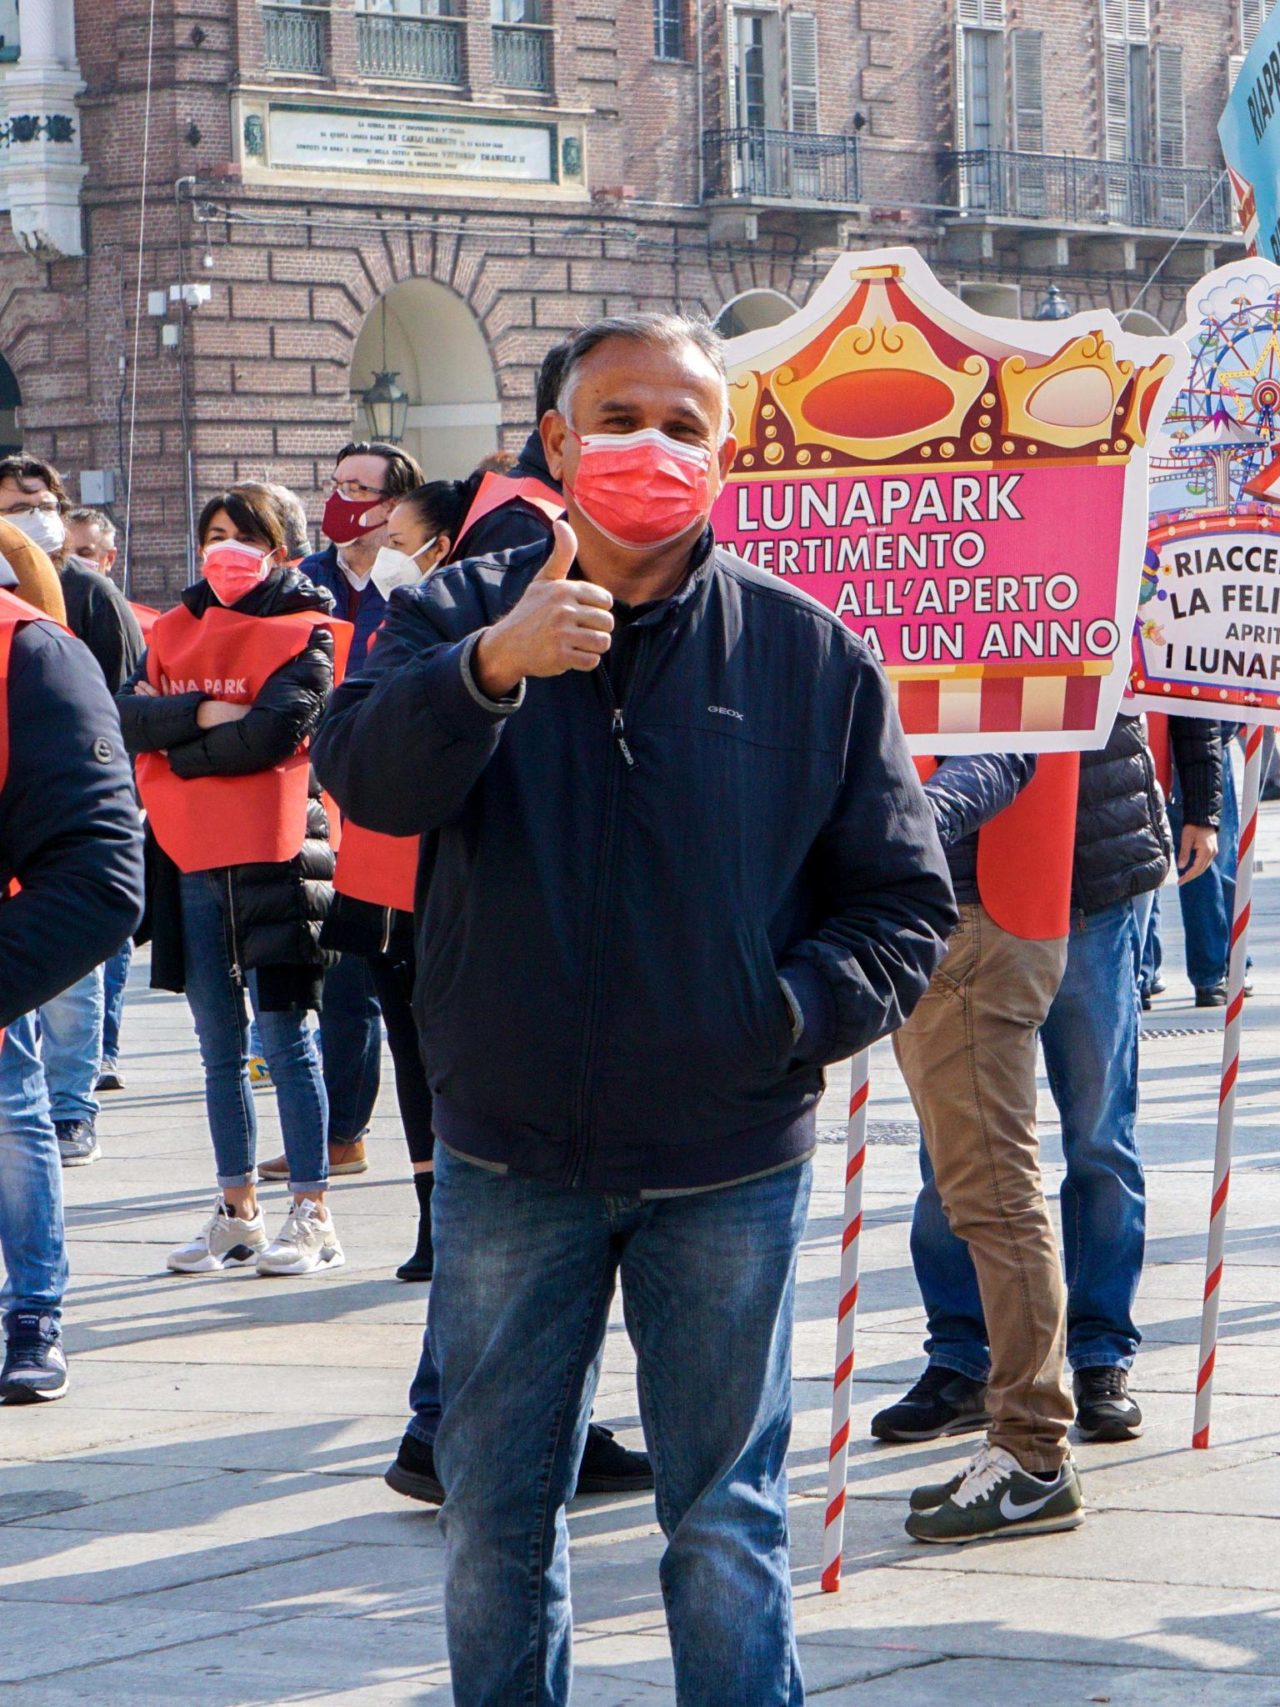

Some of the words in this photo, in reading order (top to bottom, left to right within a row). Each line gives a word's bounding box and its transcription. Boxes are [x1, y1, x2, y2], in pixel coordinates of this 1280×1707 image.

[736, 473, 1025, 533] LUNAPARK
[716, 530, 986, 575] VERTIMENTO
[1170, 588, 1211, 620] LA
[900, 622, 966, 662] UN
[979, 618, 1121, 660] ANNO
[1165, 643, 1174, 669] I
[203, 677, 247, 695] PARK
[707, 705, 744, 721] GEOX
